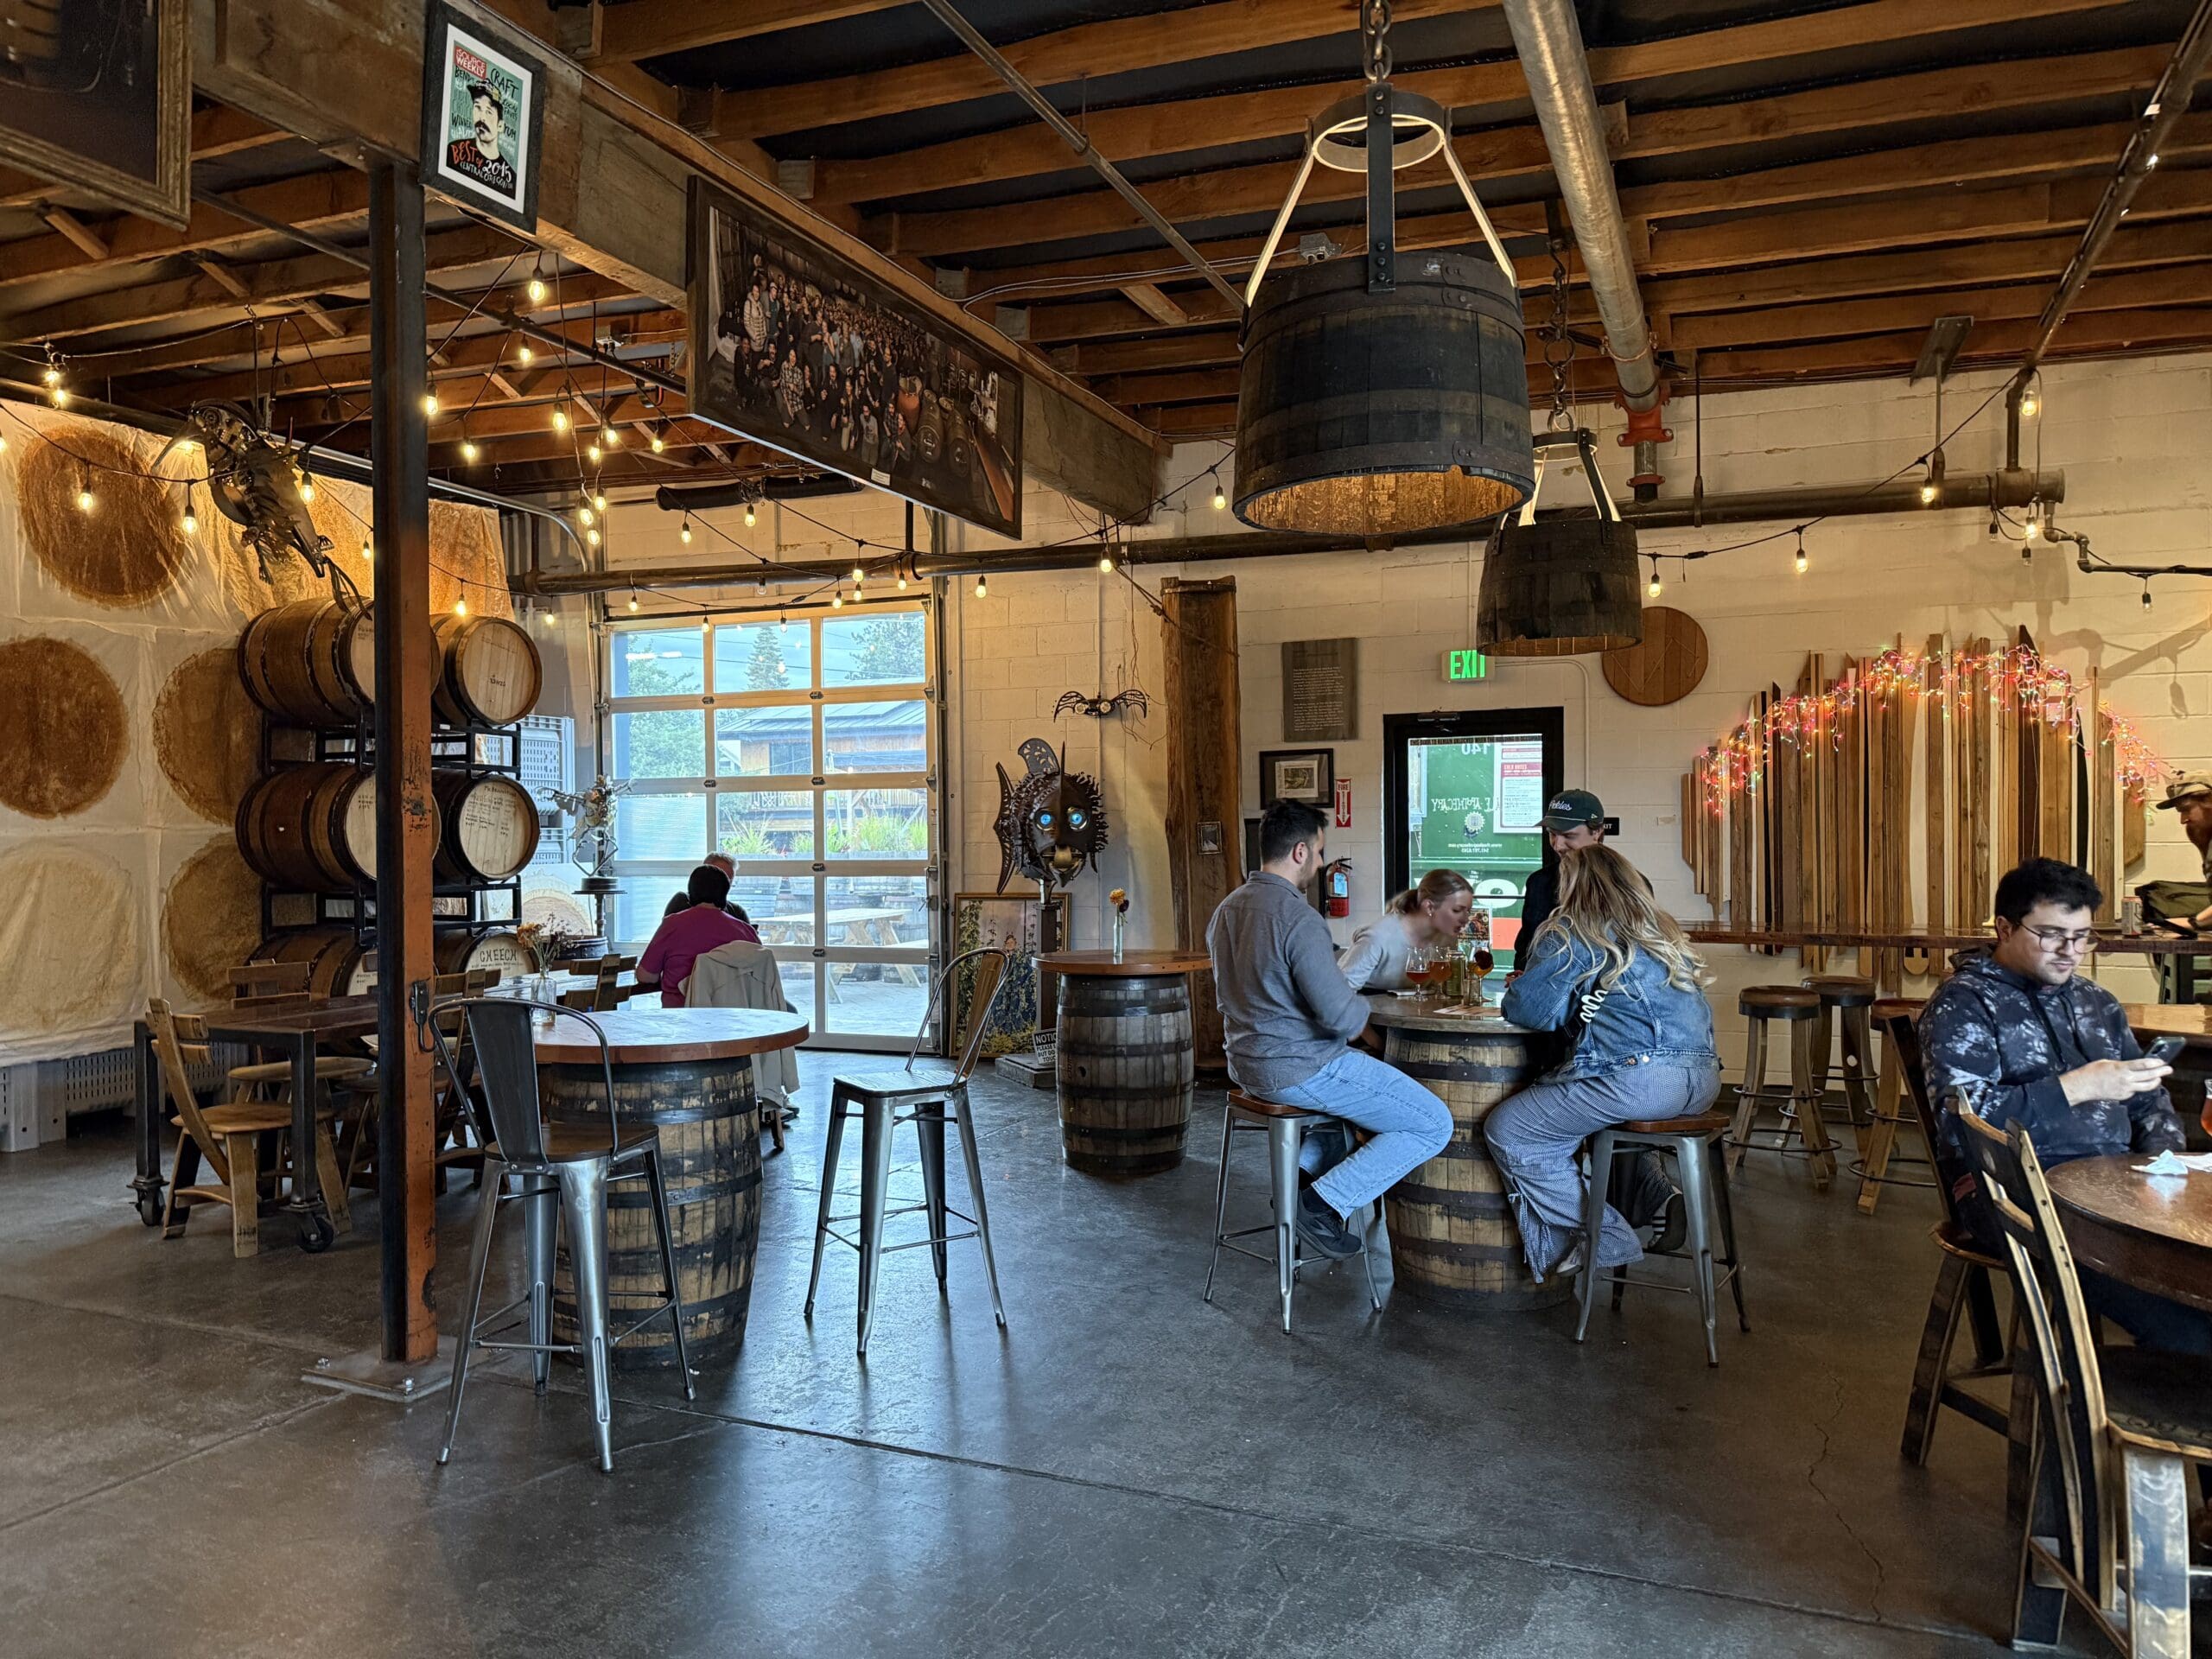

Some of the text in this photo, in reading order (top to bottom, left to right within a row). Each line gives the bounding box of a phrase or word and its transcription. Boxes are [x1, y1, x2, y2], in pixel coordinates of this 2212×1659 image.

[456, 48, 486, 68] SOURCE
[456, 56, 485, 78] WEEKLY
[491, 67, 519, 99] CRAFT
[451, 141, 477, 165] BEST
[460, 161, 484, 178] CENTRAL
[482, 159, 512, 183] 2015
[480, 949, 517, 963] CHEECH
[1035, 1033, 1057, 1044] NOTIC
